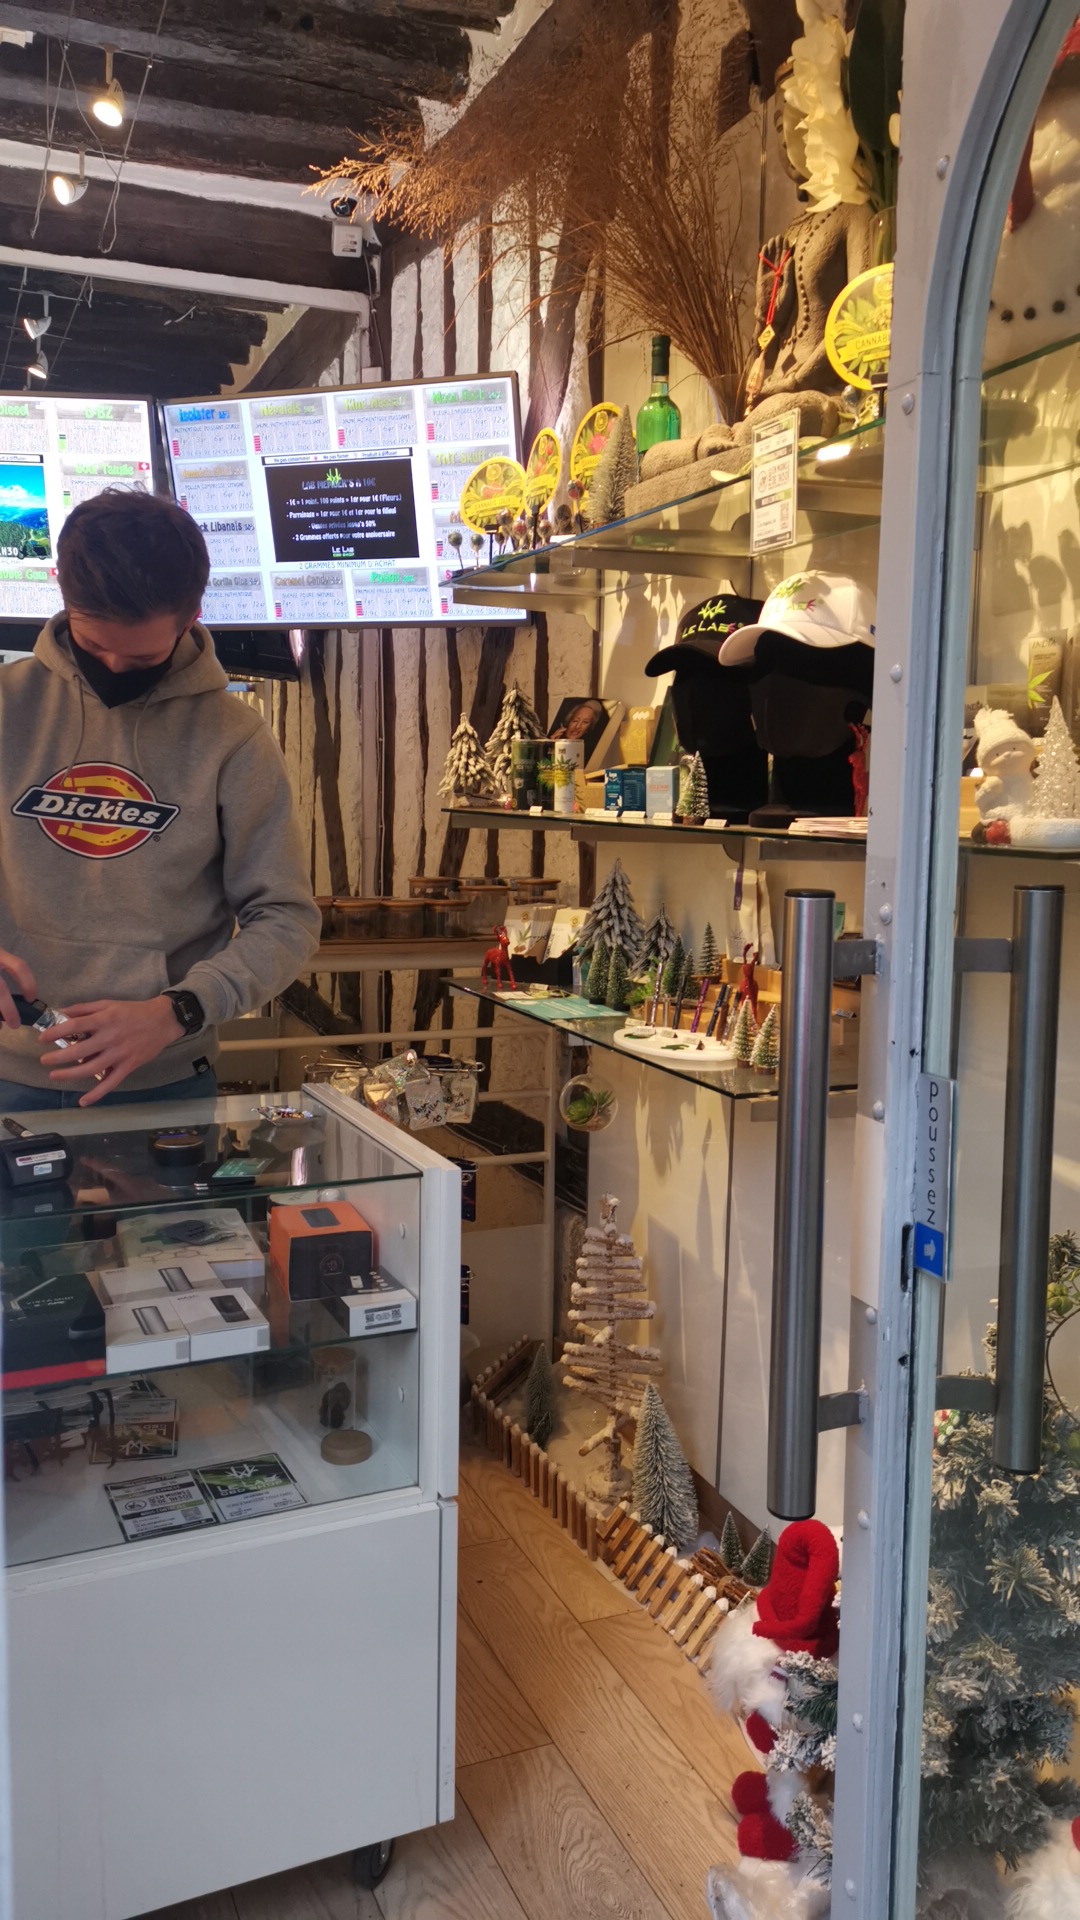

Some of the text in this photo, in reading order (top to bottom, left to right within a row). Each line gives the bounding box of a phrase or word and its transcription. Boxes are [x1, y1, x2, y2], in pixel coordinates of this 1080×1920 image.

[210, 520, 242, 532] Libanais
[0, 546, 19, 557] H30
[305, 561, 335, 569] GRAMMES
[682, 624, 697, 639] LE
[31, 794, 161, 824] Dickies
